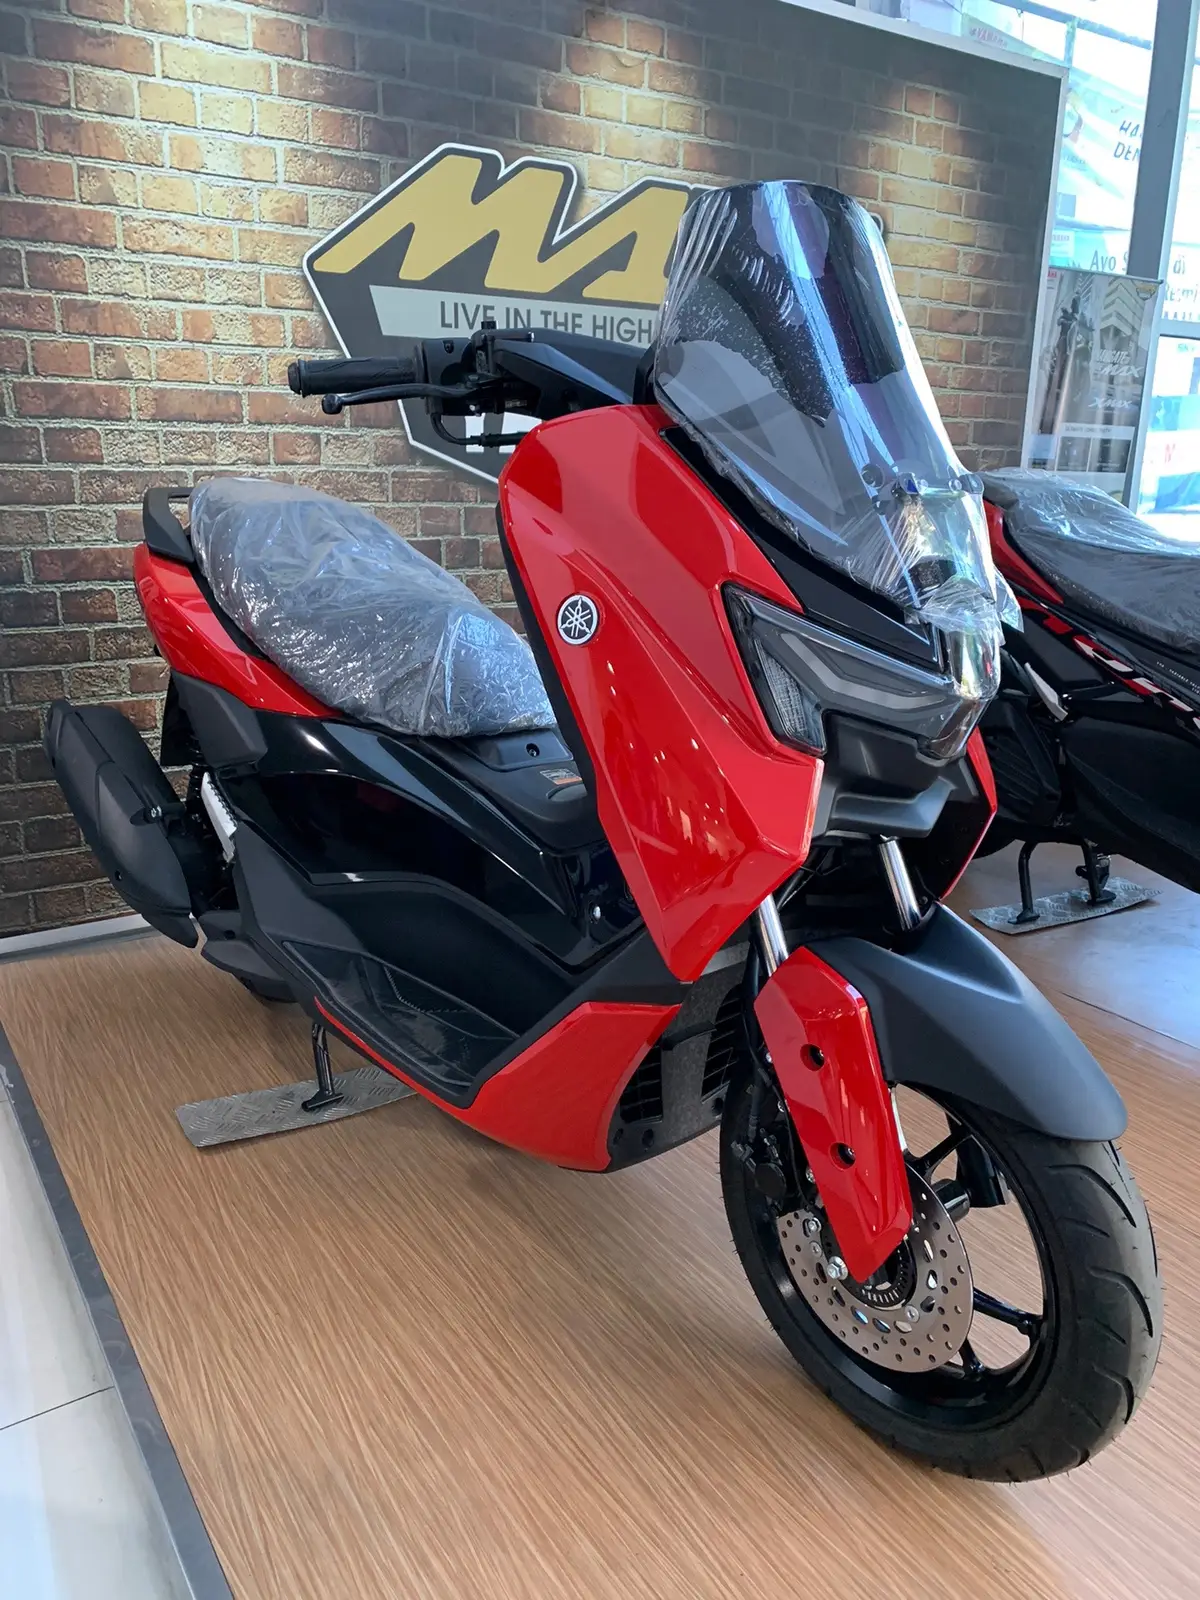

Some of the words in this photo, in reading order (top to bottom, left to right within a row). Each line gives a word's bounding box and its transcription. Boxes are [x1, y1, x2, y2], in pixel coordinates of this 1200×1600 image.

[1118, 119, 1142, 138] HA
[313, 154, 690, 304] MA
[440, 301, 496, 329] LIVE
[505, 307, 531, 329] IN
[540, 310, 583, 334] THE
